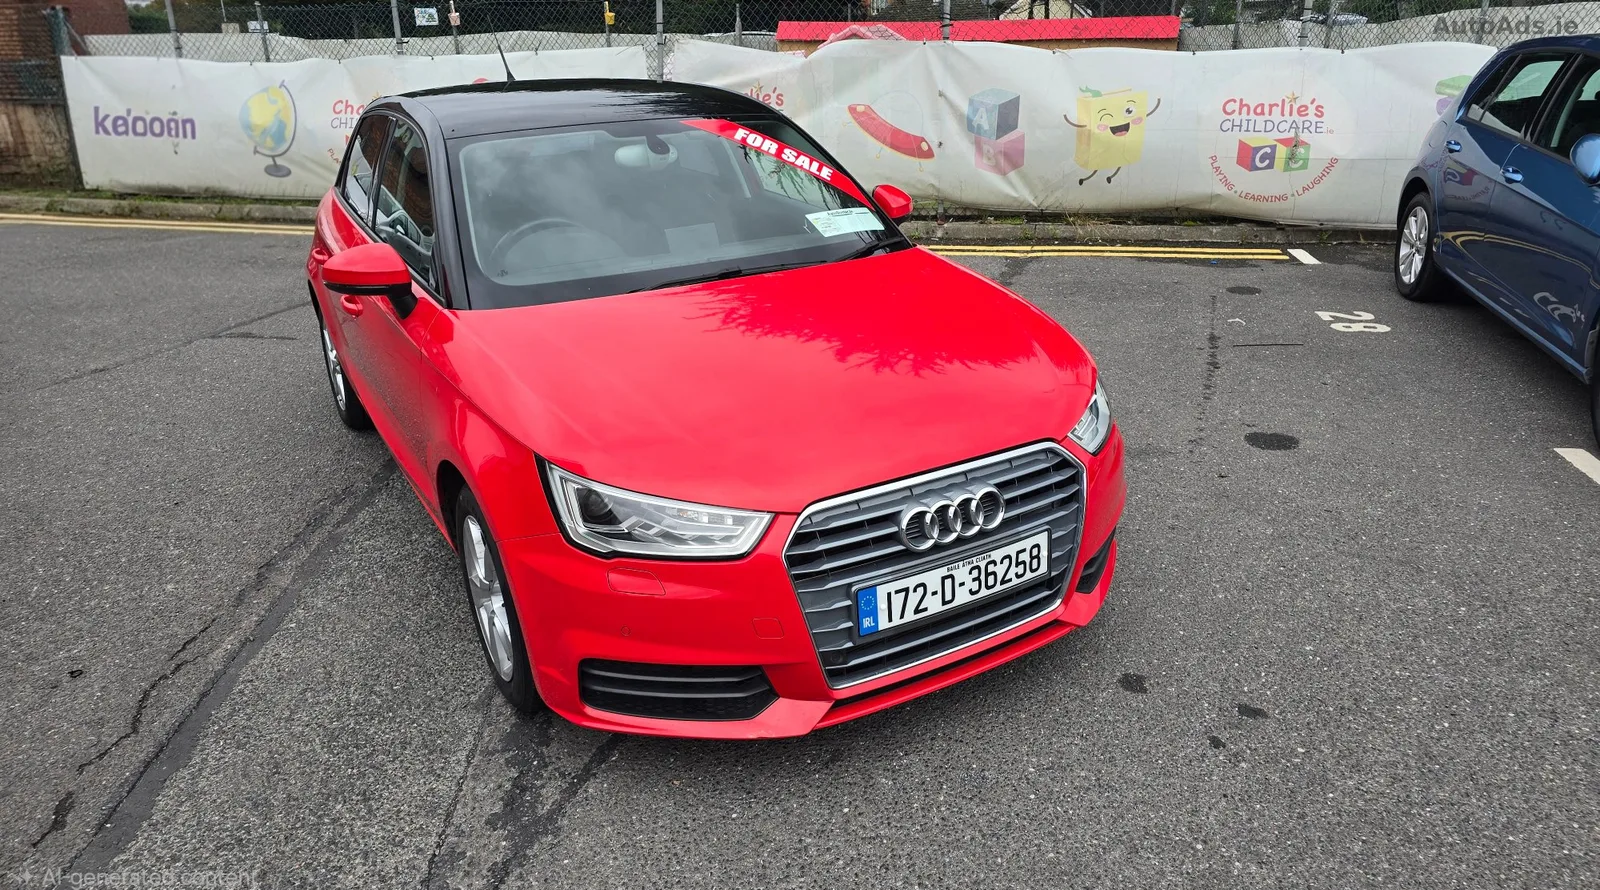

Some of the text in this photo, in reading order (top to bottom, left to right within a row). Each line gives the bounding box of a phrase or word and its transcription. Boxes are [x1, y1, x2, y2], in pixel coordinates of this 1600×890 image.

[972, 107, 990, 130] A
[1222, 97, 1325, 118] Charlie's
[734, 128, 834, 181] FOR SALE
[1255, 146, 1272, 168] C
[1209, 154, 1339, 203] PLAYING LEARNING LAUGHING
[1314, 310, 1392, 333] 28
[946, 564, 960, 573] BAILE
[886, 543, 1042, 624] 172-D-36258
[862, 615, 876, 629] IRL
